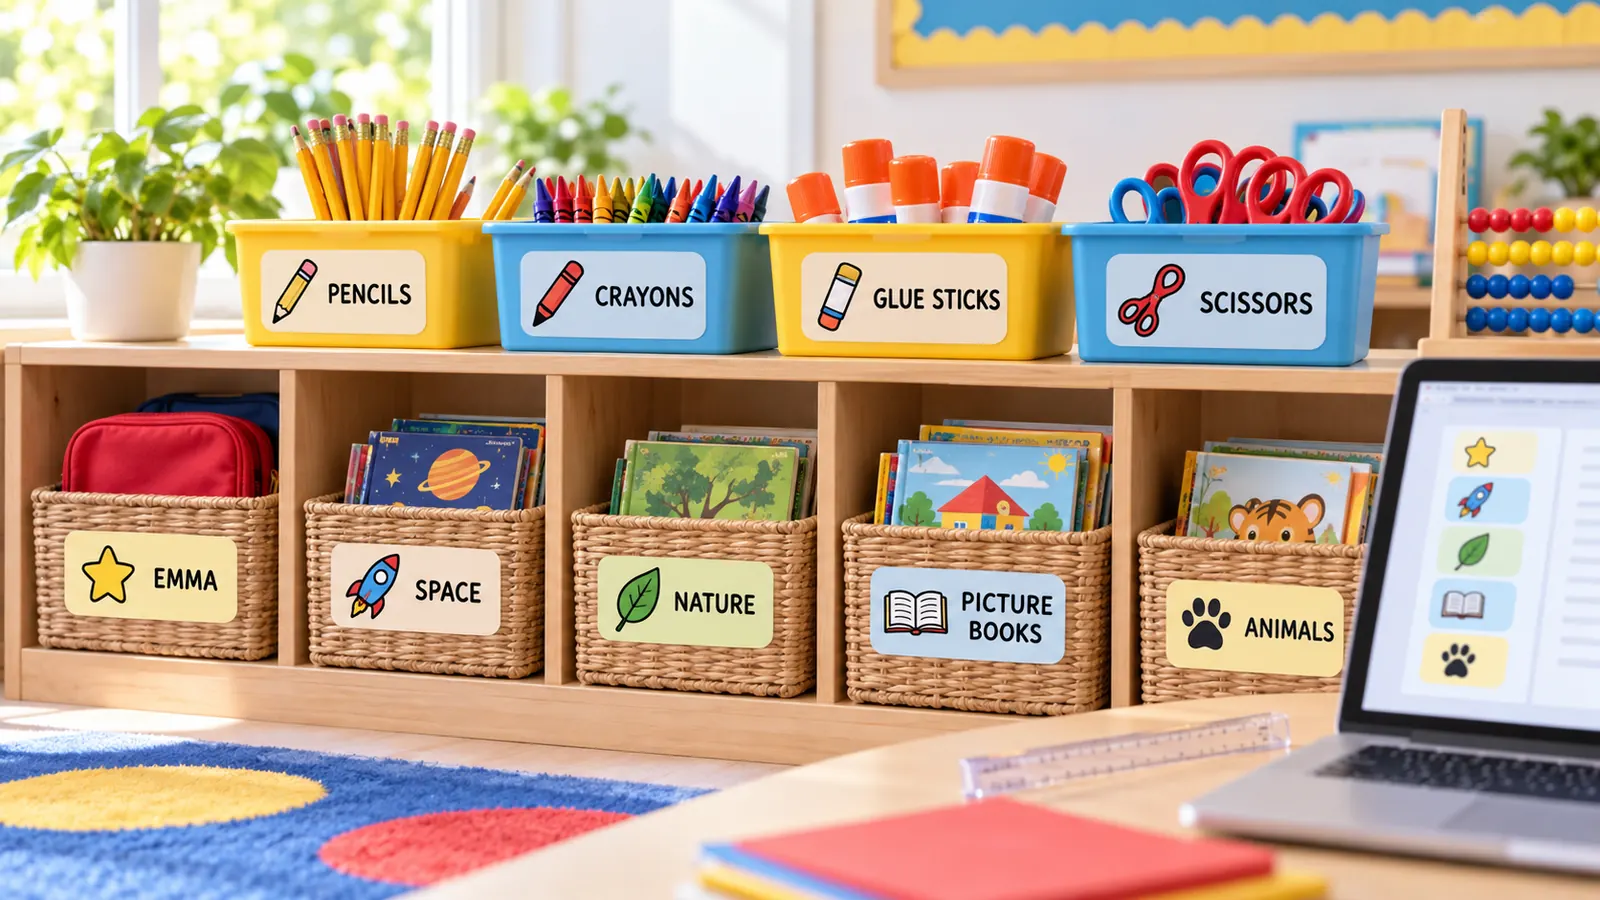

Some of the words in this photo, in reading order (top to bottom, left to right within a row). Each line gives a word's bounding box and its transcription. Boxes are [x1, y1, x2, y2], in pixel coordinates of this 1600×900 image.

[329, 283, 411, 305] PENCILS
[596, 286, 693, 308] CRAYONS
[873, 288, 924, 310] GLUE
[932, 289, 1000, 311] STICKS
[1200, 291, 1312, 314] SCISSORS
[154, 568, 218, 592] EMMA
[416, 580, 481, 604] SPACE
[675, 592, 755, 615] NATURE
[962, 592, 1053, 615] PICTURE
[970, 621, 1041, 644] BOOKS
[1245, 617, 1334, 642] ANIMALS
